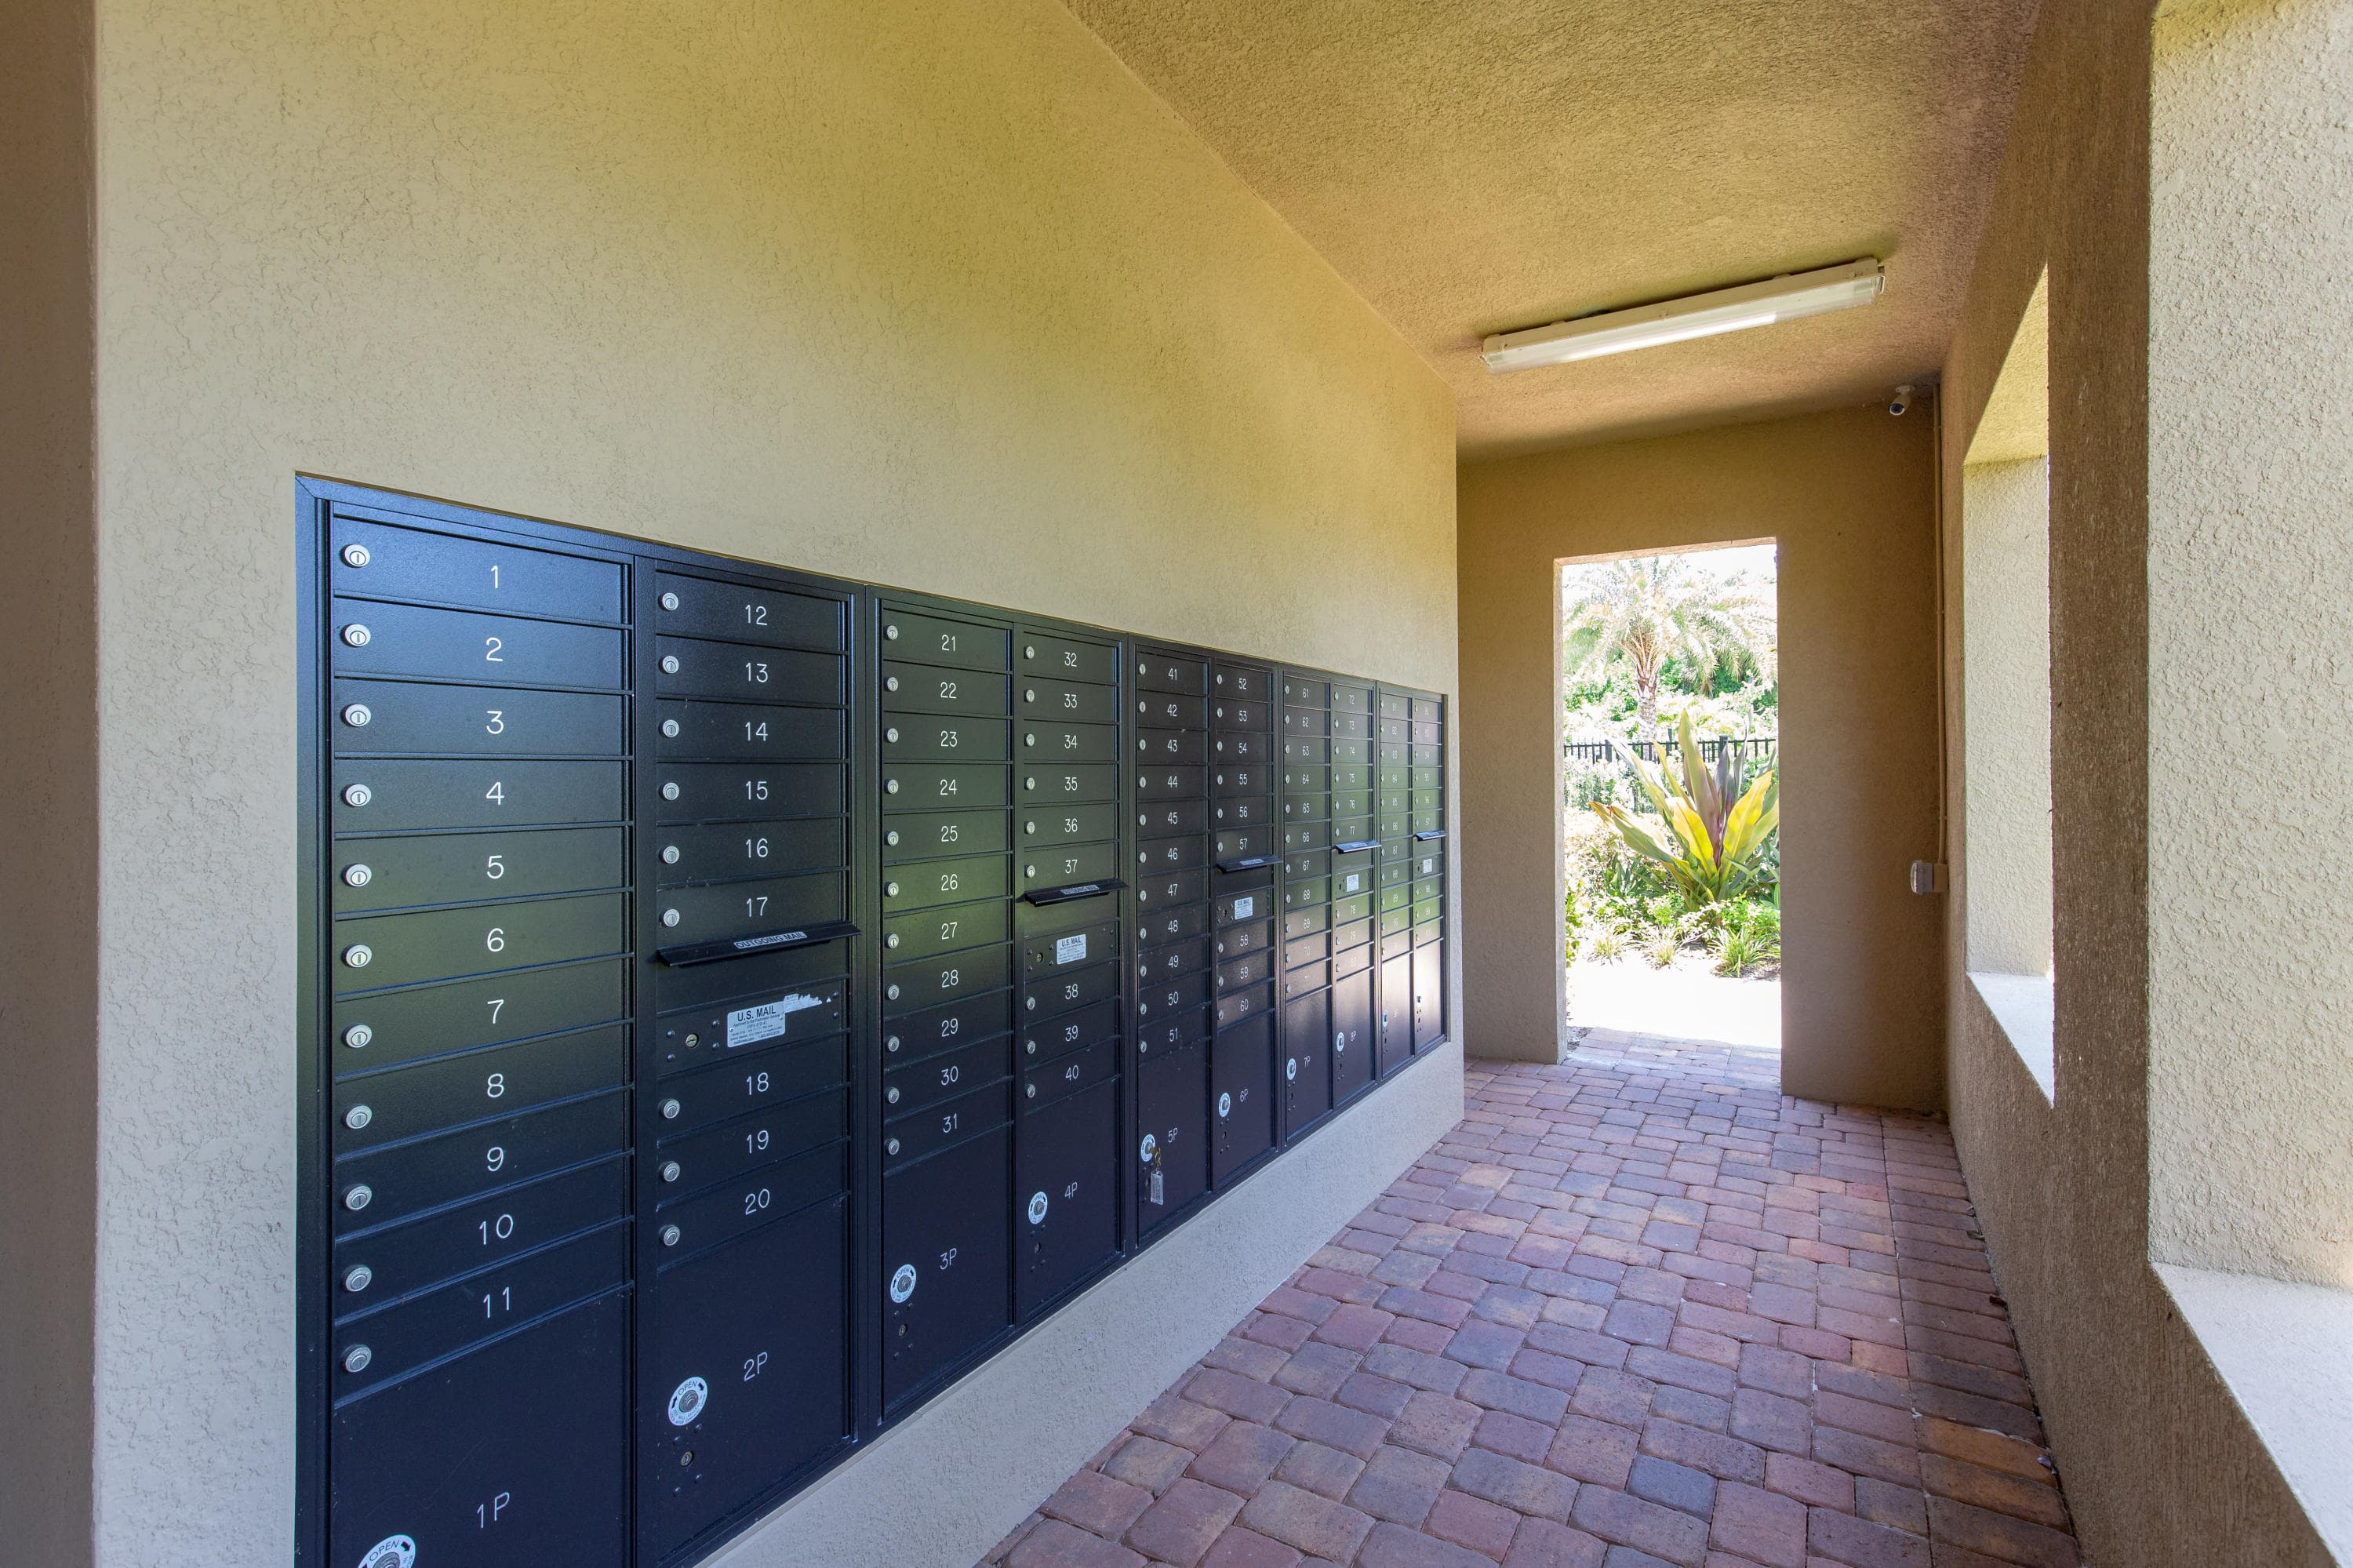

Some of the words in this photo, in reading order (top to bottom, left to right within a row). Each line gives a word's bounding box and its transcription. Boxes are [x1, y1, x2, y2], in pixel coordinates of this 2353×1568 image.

[491, 566, 498, 588] 1
[746, 605, 767, 625] 12
[486, 638, 503, 661] 2
[942, 635, 955, 651] 21
[1065, 653, 1077, 667] 32
[746, 663, 768, 682] 13
[1169, 668, 1176, 680] 41
[941, 682, 956, 698] 22
[1239, 678, 1246, 689] 52
[1303, 688, 1308, 697] 61
[1349, 695, 1355, 704] 72
[1064, 694, 1077, 708] 33
[1168, 704, 1176, 716] 42
[1239, 711, 1246, 722] 53
[486, 711, 504, 734] 3
[1303, 717, 1308, 727] 62
[1349, 721, 1354, 729] 73
[746, 722, 768, 740] 14
[941, 731, 957, 747] 23
[1065, 735, 1077, 748] 34
[1168, 740, 1177, 751] 43
[1239, 743, 1246, 753] 54
[1303, 746, 1309, 755] 63
[1065, 777, 1077, 791] 35
[1168, 777, 1177, 788] 44
[1240, 774, 1247, 784] 55
[1303, 774, 1309, 784] 64
[1350, 773, 1355, 782] 75
[486, 782, 504, 805] 4
[746, 781, 767, 799] 15
[940, 780, 957, 795] 24
[1240, 806, 1247, 817] 56
[1304, 803, 1309, 813] 65
[1350, 800, 1355, 809] 76
[1065, 818, 1077, 832] 36
[1168, 813, 1177, 824] 45
[941, 826, 958, 842] 25
[1303, 832, 1309, 842] 66
[1350, 826, 1355, 835] 77
[746, 839, 768, 857] 16
[1240, 839, 1247, 849] 57
[1168, 848, 1177, 860] 46
[487, 856, 504, 879] 5
[1066, 860, 1077, 873] 37
[1304, 860, 1309, 871] 67
[941, 874, 957, 890] 26
[1168, 884, 1177, 896] 47
[1304, 890, 1310, 900] 68
[747, 897, 767, 917] 17
[1351, 905, 1355, 914] 78
[942, 922, 957, 939] 27
[1168, 920, 1177, 932] 48
[1304, 919, 1310, 929] 69
[487, 928, 504, 951] 6
[736, 936, 783, 948] OUTGOING
[784, 932, 806, 940] MAIL
[1240, 935, 1248, 946] 58
[1169, 955, 1178, 968] 49
[942, 970, 958, 988] 28
[1241, 967, 1248, 979] 59
[1066, 984, 1078, 999] 38
[1169, 991, 1178, 1006] 50
[488, 999, 504, 1024] 7
[1241, 999, 1248, 1011] 60
[737, 1010, 754, 1021] U.S.
[757, 1006, 776, 1017] MAIL
[942, 1018, 958, 1036] 29
[1066, 1025, 1078, 1041] 39
[1169, 1028, 1177, 1042] 51
[1304, 1056, 1310, 1066] 7P
[941, 1066, 958, 1085] 30
[1066, 1065, 1078, 1081] 40
[487, 1074, 504, 1097] 8
[747, 1072, 769, 1095] 18
[1240, 1089, 1248, 1102] 6P
[944, 1114, 956, 1133] 31
[747, 1130, 769, 1153] 19
[1169, 1128, 1177, 1142] 5P
[487, 1147, 503, 1171] 9
[1065, 1182, 1077, 1199] 4P
[746, 1189, 769, 1215] 20
[479, 1214, 513, 1245] 10
[940, 1248, 956, 1269] 3P
[897, 1268, 910, 1279] OPEN
[484, 1287, 509, 1318] 11
[744, 1352, 767, 1381] 2P
[678, 1381, 698, 1395] OPEN
[478, 1493, 509, 1528] 1P
[369, 1540, 400, 1562] OPEN
